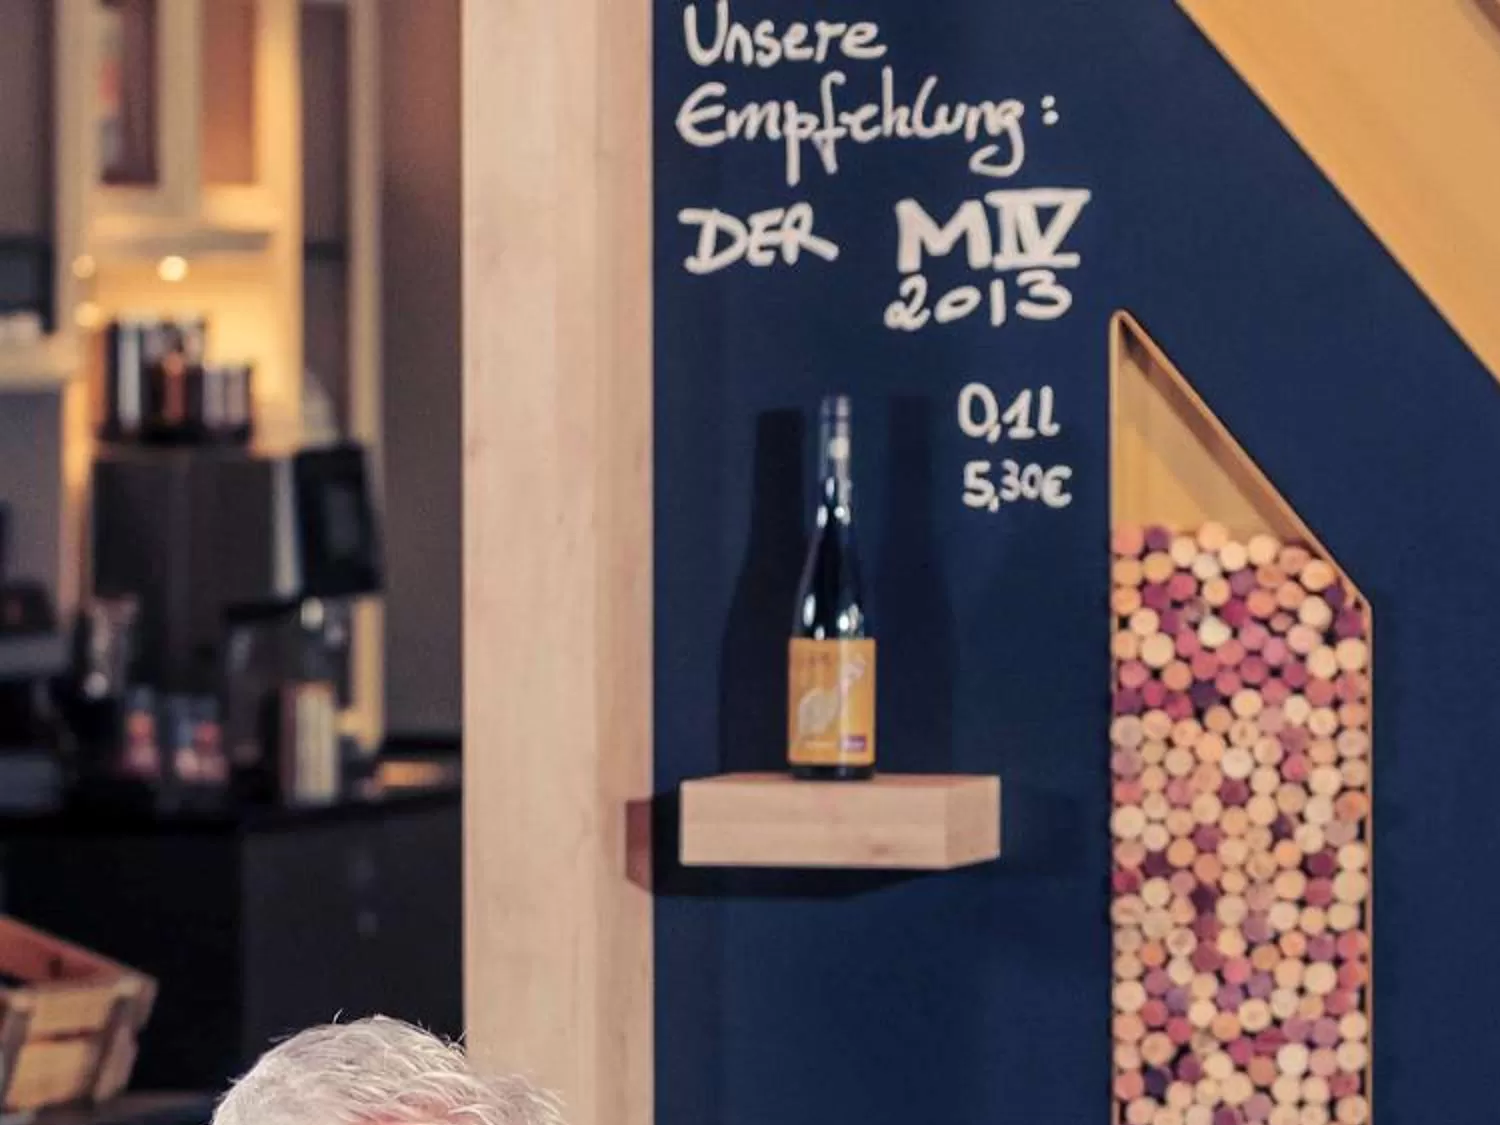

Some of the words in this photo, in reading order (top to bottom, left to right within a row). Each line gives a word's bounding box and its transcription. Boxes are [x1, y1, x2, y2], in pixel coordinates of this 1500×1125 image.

[683, 0, 887, 67] Unsere
[678, 202, 839, 274] DER
[884, 269, 1072, 331] 2013
[962, 458, 1073, 513] 5,30€
